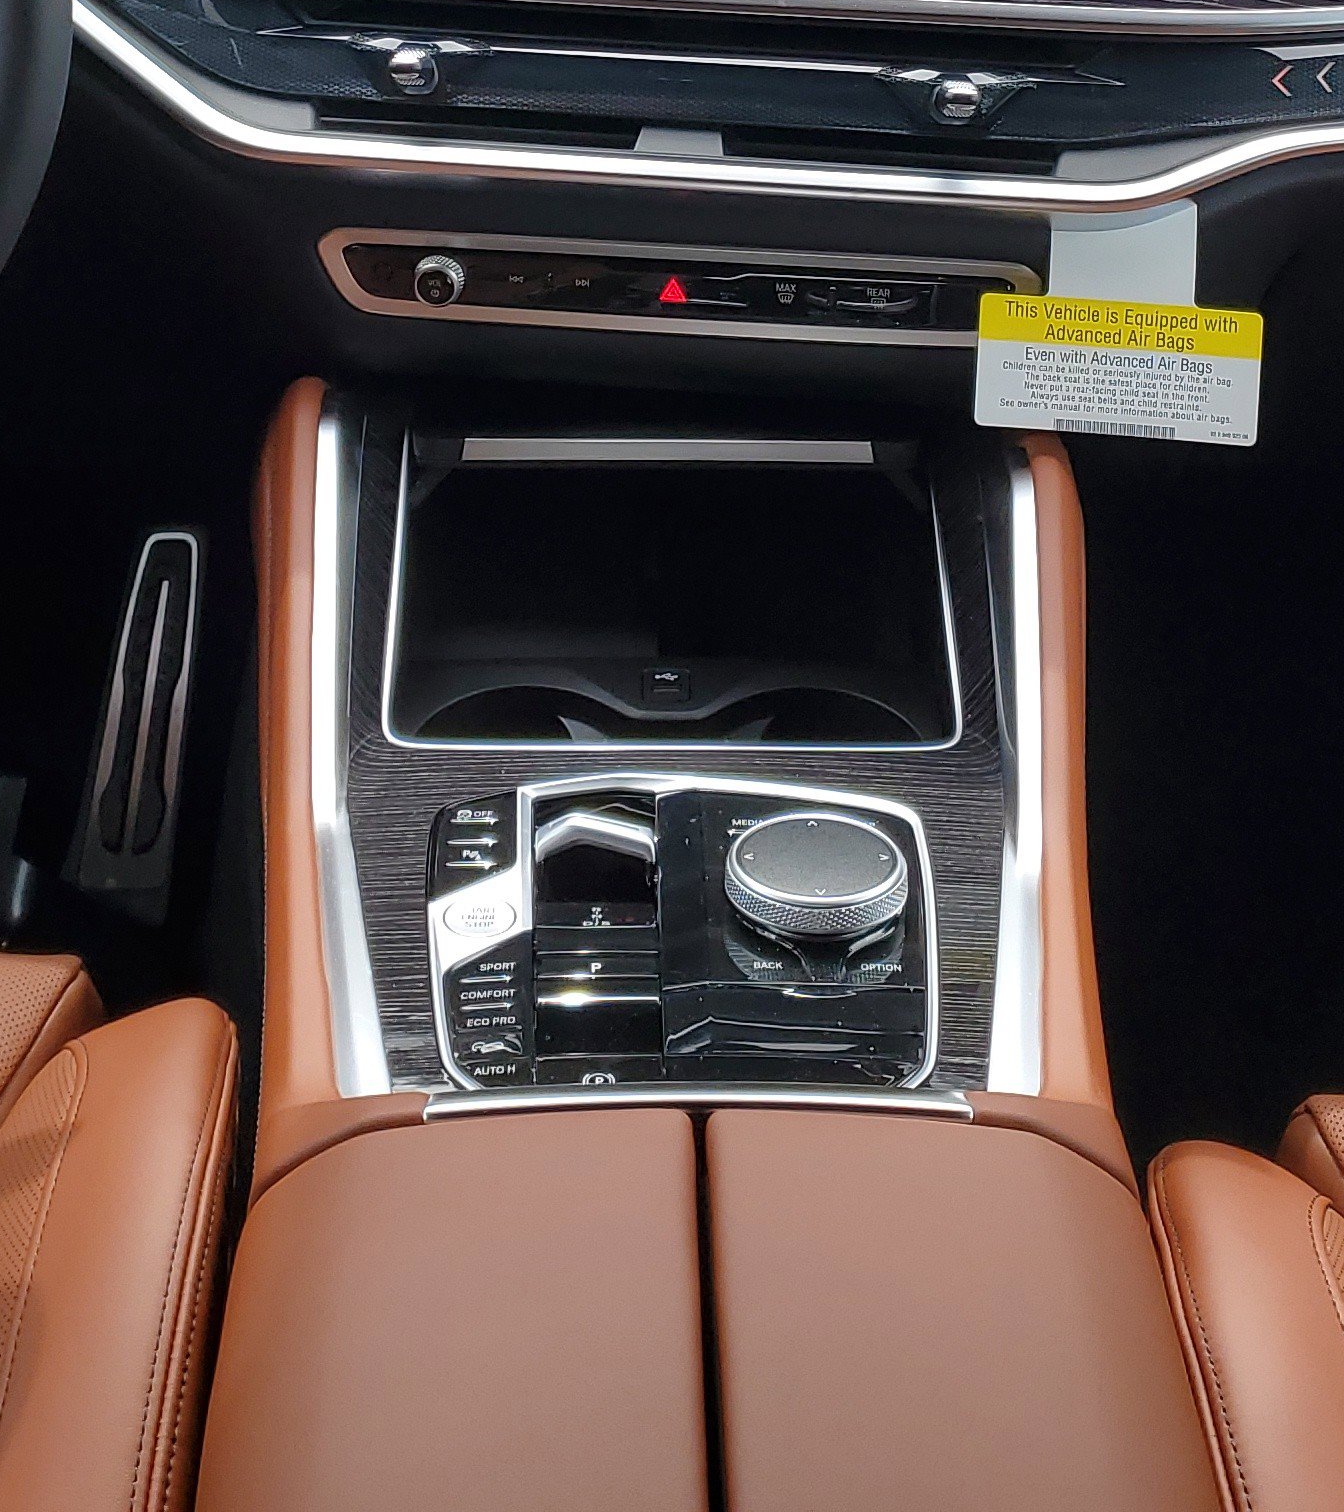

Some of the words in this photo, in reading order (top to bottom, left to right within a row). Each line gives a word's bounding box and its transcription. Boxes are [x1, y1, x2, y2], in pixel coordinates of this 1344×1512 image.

[775, 282, 797, 293] MAX
[866, 287, 891, 298] REAR
[1004, 300, 1038, 319] This
[1043, 302, 1100, 323] Vehicle
[1105, 307, 1119, 324] is
[1124, 308, 1199, 332] Equipped
[1204, 314, 1238, 334] with
[1044, 324, 1122, 345] Advanced
[1126, 329, 1151, 347] Air
[1156, 331, 1195, 353] Bags
[1025, 346, 1056, 362] Even
[1059, 349, 1087, 364] with
[1090, 351, 1154, 369] Advanced
[1157, 356, 1177, 371] Air
[1180, 358, 1213, 376] Bags
[1002, 361, 1036, 372] Children
[1039, 364, 1053, 372] can
[1056, 364, 1066, 374] be
[1068, 365, 1090, 375] killed
[1092, 368, 1101, 376] or
[1103, 368, 1141, 379] seriously
[1143, 370, 1172, 382] injured
[1174, 373, 1185, 384] by
[1187, 374, 1200, 383] the
[1202, 375, 1214, 385] air
[1025, 371, 1040, 381] The
[1042, 372, 1061, 382] back
[1063, 375, 1081, 384] seat
[1083, 375, 1091, 384] is
[1092, 376, 1106, 385] the
[1108, 377, 1133, 388] safest
[1135, 380, 1157, 389] place
[1159, 381, 1171, 391] for
[1024, 381, 1047, 391] Never
[1049, 383, 1063, 393] put
[1119, 388, 1139, 398] child
[1141, 390, 1159, 399] seat
[1161, 391, 1170, 400] in
[1172, 391, 1185, 401] the
[1030, 391, 1059, 402] Always
[1061, 394, 1076, 402] use
[1078, 394, 1096, 403] seat
[1097, 395, 1118, 405] belts
[1119, 397, 1135, 407] and
[1137, 399, 1158, 408] child
[1017, 400, 1049, 409] owner's
[1051, 403, 1080, 412] manual
[1083, 403, 1095, 413] for
[1097, 406, 1118, 415] more
[1120, 406, 1169, 418] information
[1171, 411, 1195, 421] about
[1197, 413, 1208, 422] air
[473, 810, 494, 818] OFF
[479, 962, 516, 972] SPORT
[590, 962, 602, 973] P
[753, 961, 783, 970] BACK
[860, 963, 902, 972] OPTION
[460, 989, 516, 1000] COMFORT
[466, 1017, 490, 1027] ECO
[492, 1016, 516, 1025] PRO
[473, 1066, 505, 1076] AUTO
[506, 1064, 516, 1074] H
